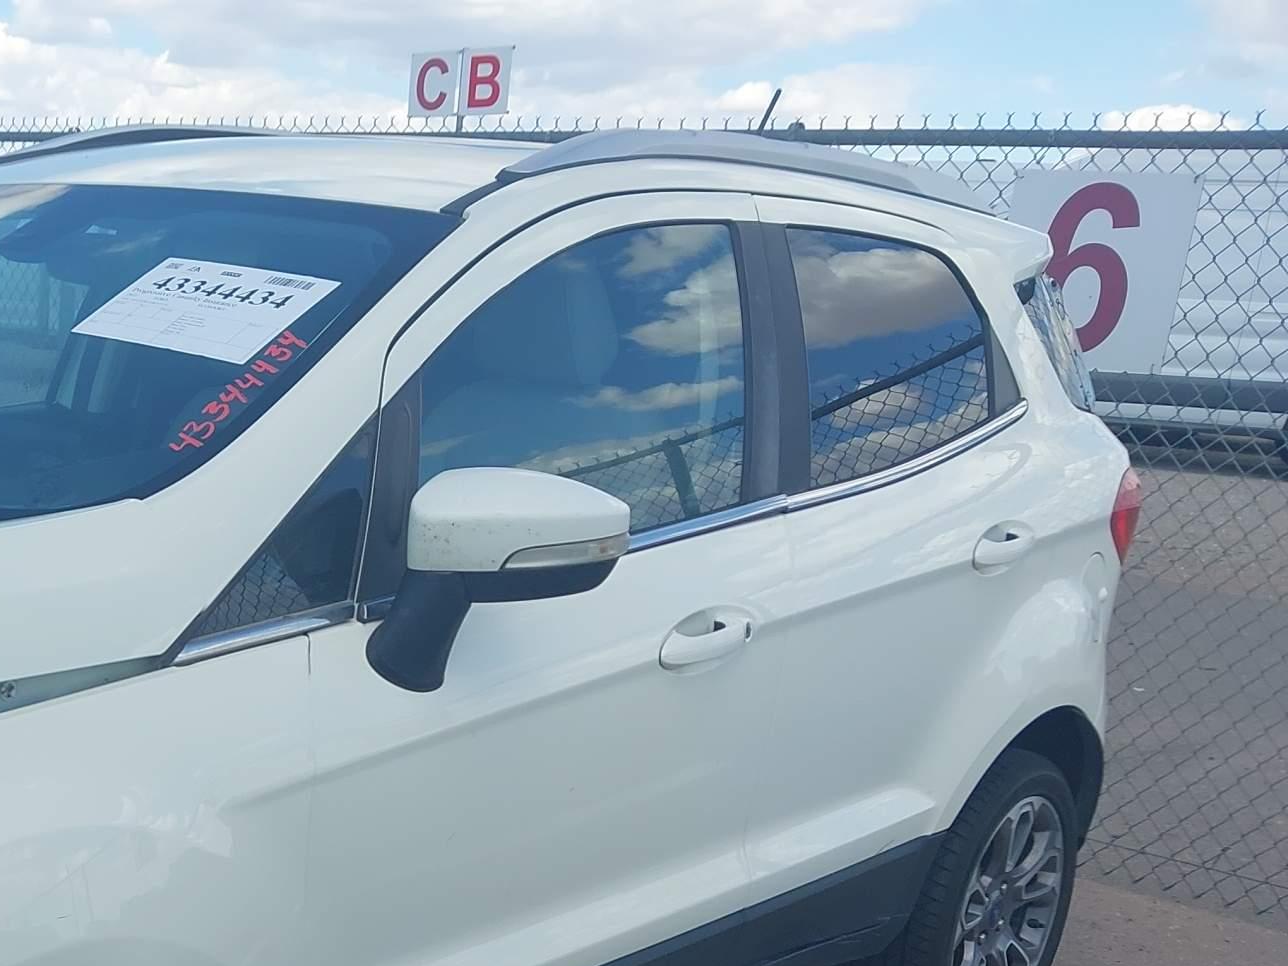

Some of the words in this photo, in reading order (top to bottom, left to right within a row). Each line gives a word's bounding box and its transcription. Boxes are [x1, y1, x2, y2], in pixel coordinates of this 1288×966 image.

[416, 58, 449, 111] C
[467, 55, 501, 108] B
[152, 276, 295, 309] 43344434
[1043, 182, 1141, 352] 6
[168, 329, 310, 453] 43344434
